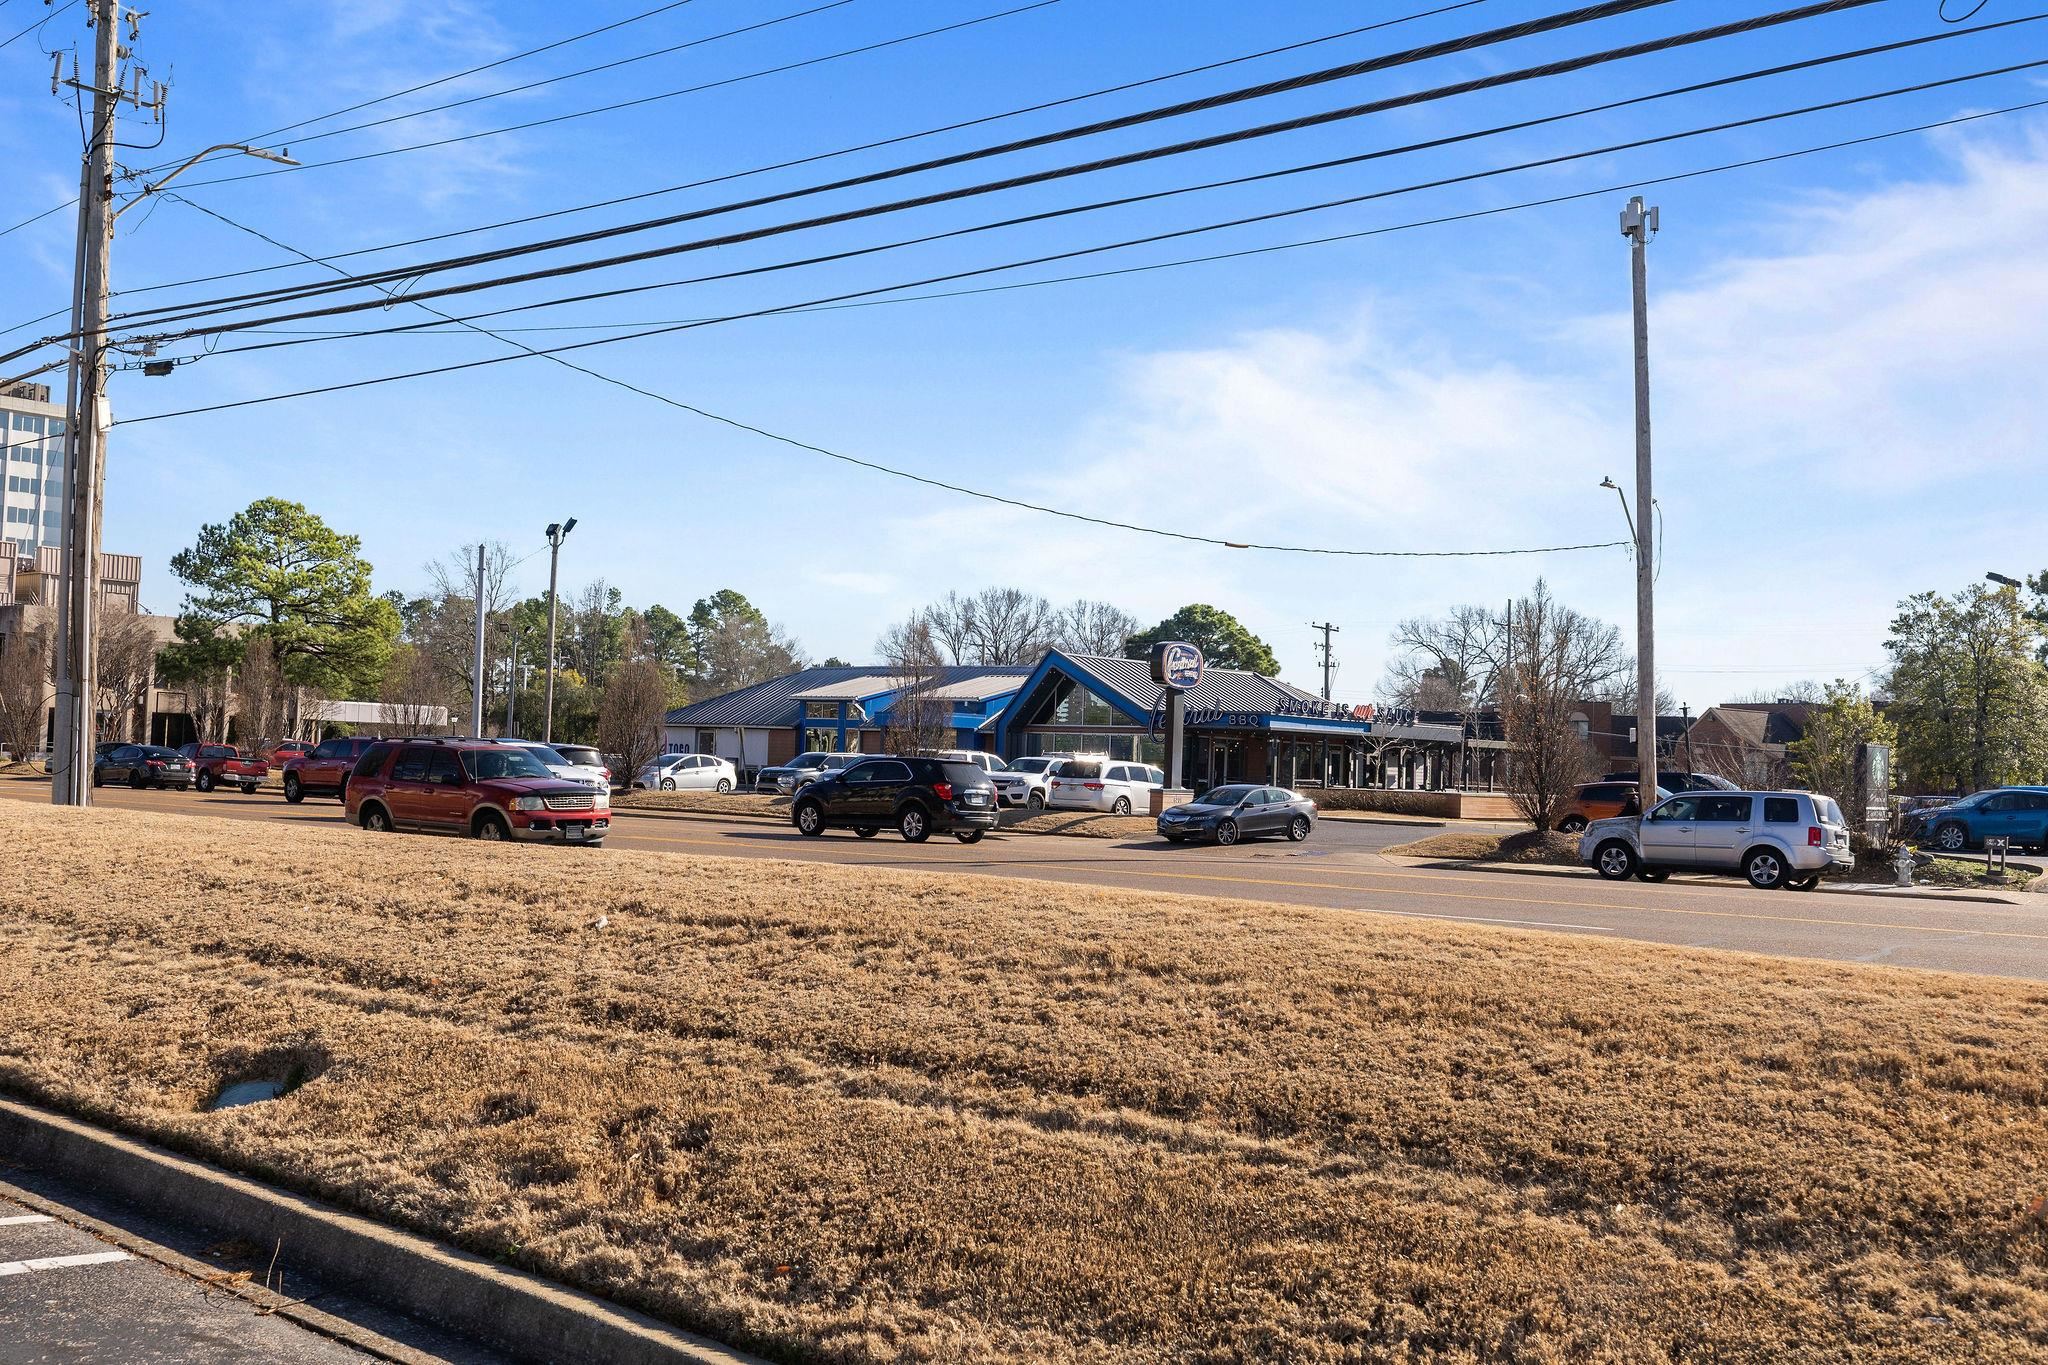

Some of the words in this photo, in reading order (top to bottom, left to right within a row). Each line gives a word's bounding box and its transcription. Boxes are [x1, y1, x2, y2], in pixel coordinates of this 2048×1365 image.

[1148, 689, 1223, 743] Ceral
[1228, 714, 1259, 727] BBQ
[1279, 697, 1329, 716] SMOKE
[1336, 703, 1349, 717] IS
[1377, 707, 1420, 722] SAUCE
